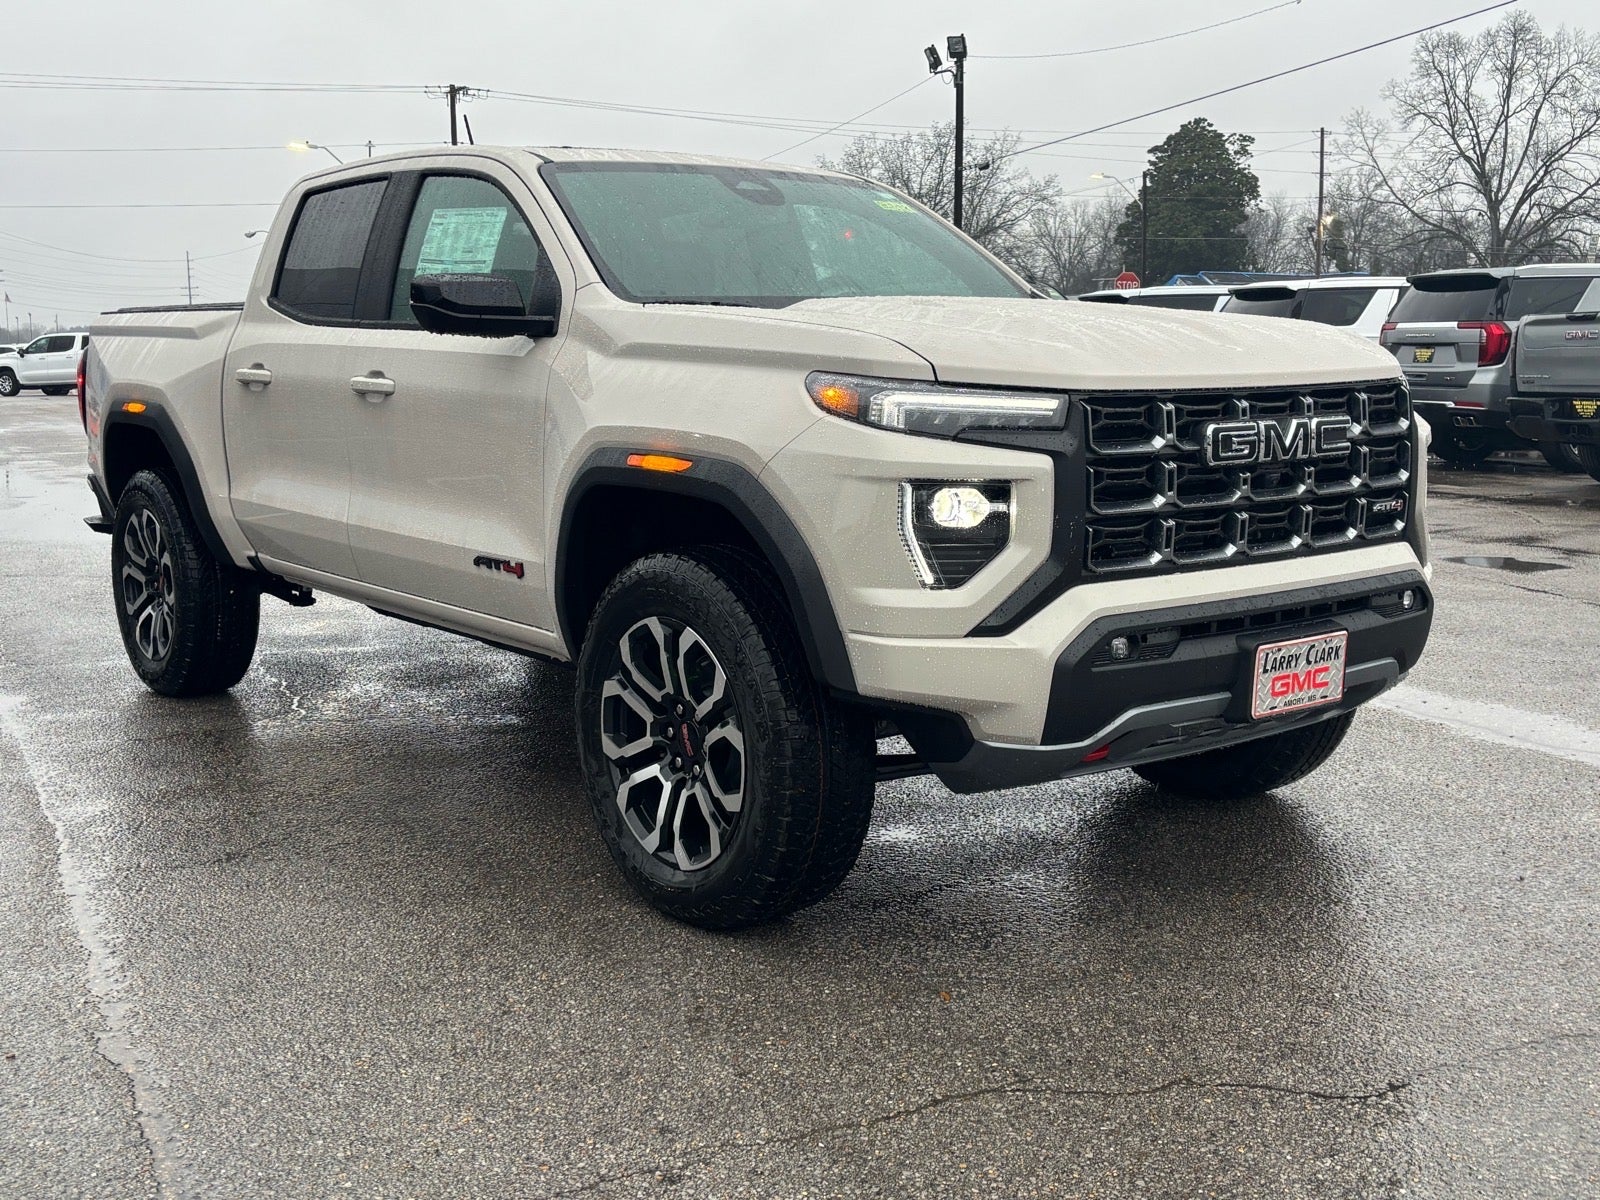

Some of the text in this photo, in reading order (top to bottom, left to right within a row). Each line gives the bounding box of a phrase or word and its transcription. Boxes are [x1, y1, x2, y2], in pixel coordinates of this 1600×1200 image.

[1116, 281, 1138, 290] STOP
[1565, 330, 1598, 339] GMC
[1206, 416, 1352, 466] GMC
[1373, 499, 1404, 512] AT4
[473, 555, 525, 579] AT4
[1271, 666, 1330, 697] GMC
